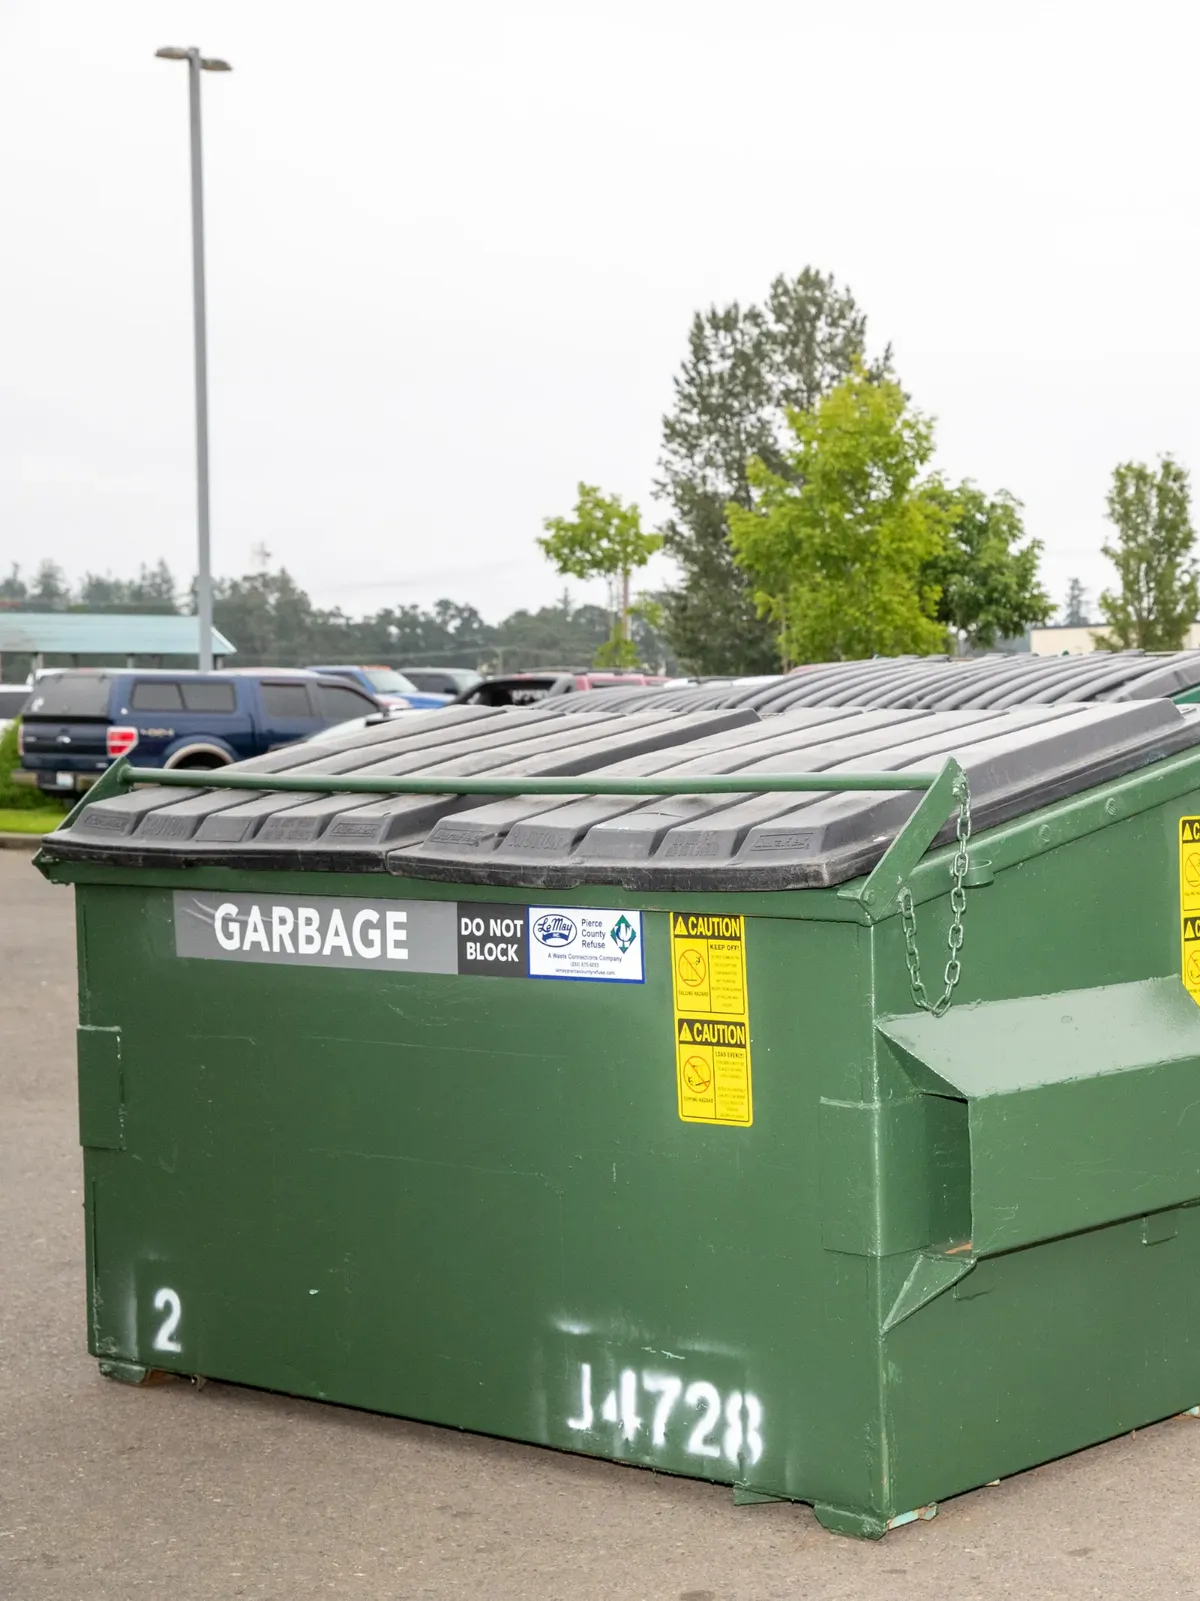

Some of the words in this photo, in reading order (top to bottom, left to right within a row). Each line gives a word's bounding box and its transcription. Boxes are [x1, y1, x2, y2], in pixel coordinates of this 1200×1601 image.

[214, 902, 409, 959] GARBAGE
[461, 918, 484, 936] DO
[490, 919, 523, 937] NOT
[581, 919, 602, 927] Pierce
[688, 916, 740, 937] CAUTION
[581, 929, 606, 939] County
[466, 942, 519, 962] BLOCK
[581, 940, 605, 948] Refuse
[599, 955, 622, 963] Company
[693, 1023, 745, 1044] CAUTION
[153, 1288, 182, 1352] 2
